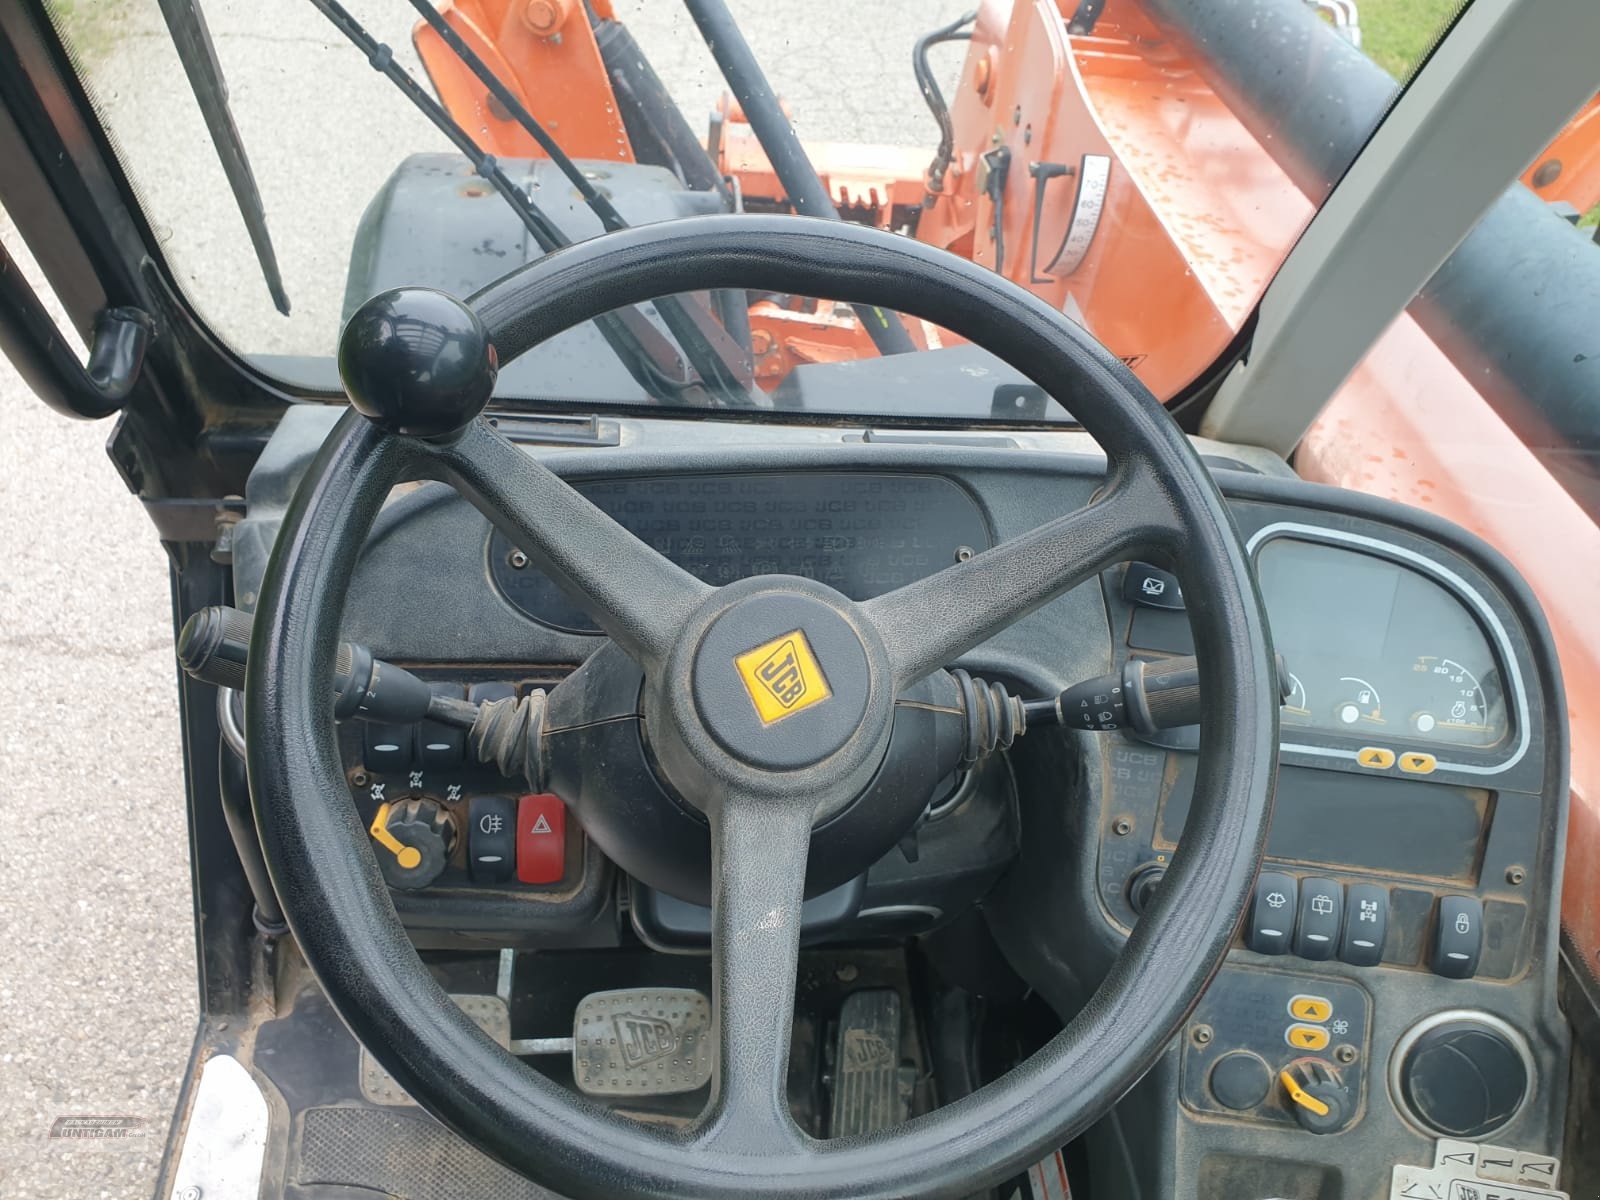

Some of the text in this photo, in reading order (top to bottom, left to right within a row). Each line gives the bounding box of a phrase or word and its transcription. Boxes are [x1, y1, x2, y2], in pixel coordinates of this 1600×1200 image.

[1081, 200, 1095, 209] 60
[761, 652, 802, 703] JCB
[1434, 666, 1449, 674] 20
[1449, 675, 1463, 683] 15
[1116, 751, 1158, 766] JCB
[626, 1021, 670, 1061] JCB
[855, 1038, 887, 1063] JCB
